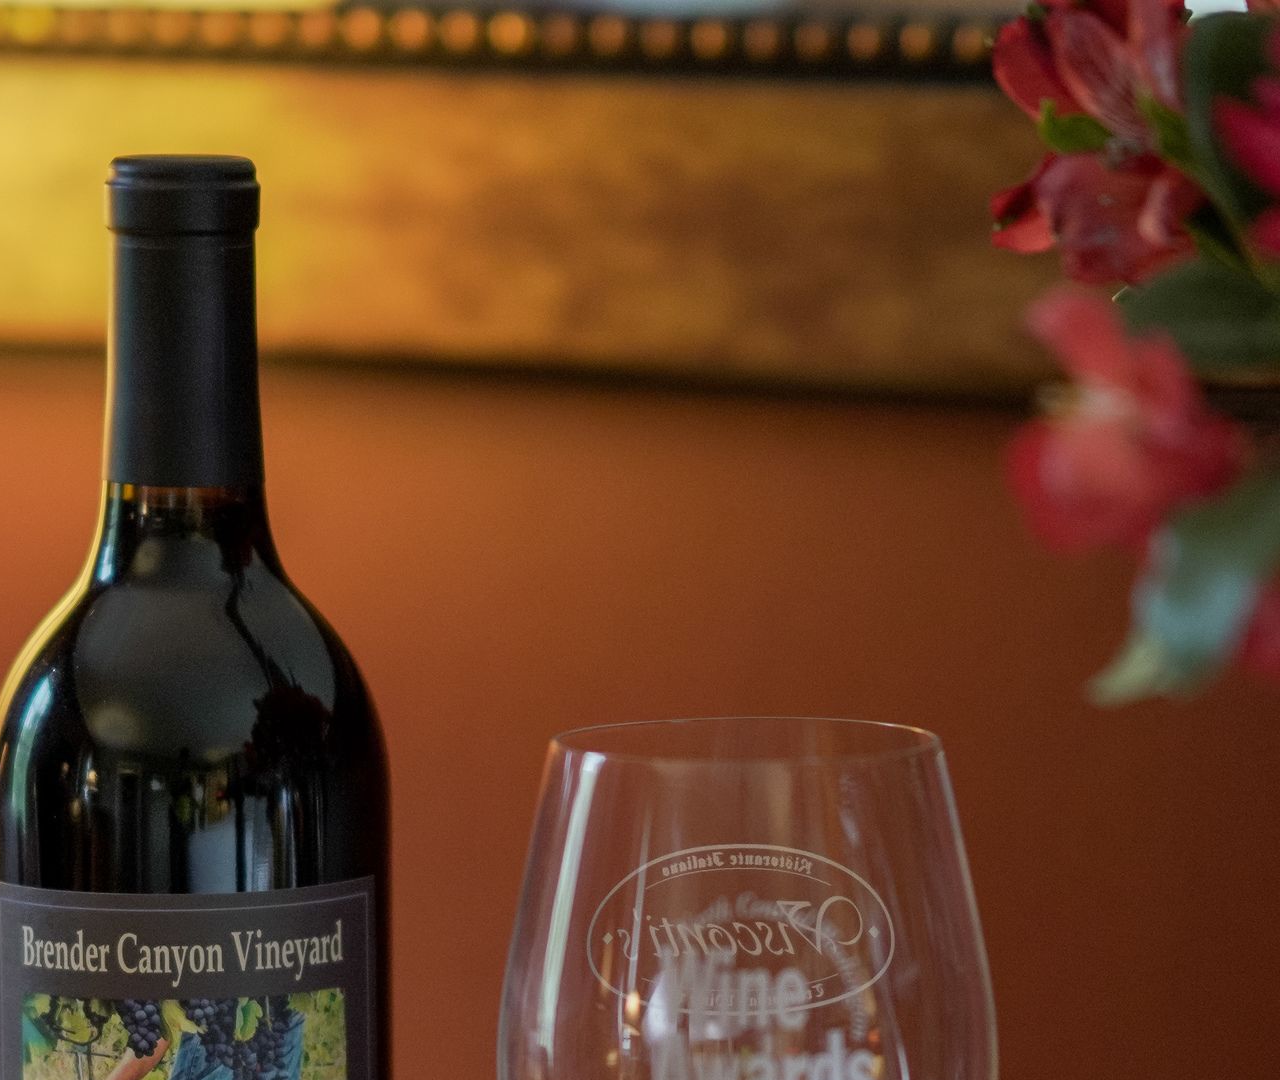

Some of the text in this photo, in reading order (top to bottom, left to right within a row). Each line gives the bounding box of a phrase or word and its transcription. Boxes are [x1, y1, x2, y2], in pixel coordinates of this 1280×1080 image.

[21, 919, 344, 987] Brender Canyon Vineyard
[654, 945, 811, 1032] Wine
